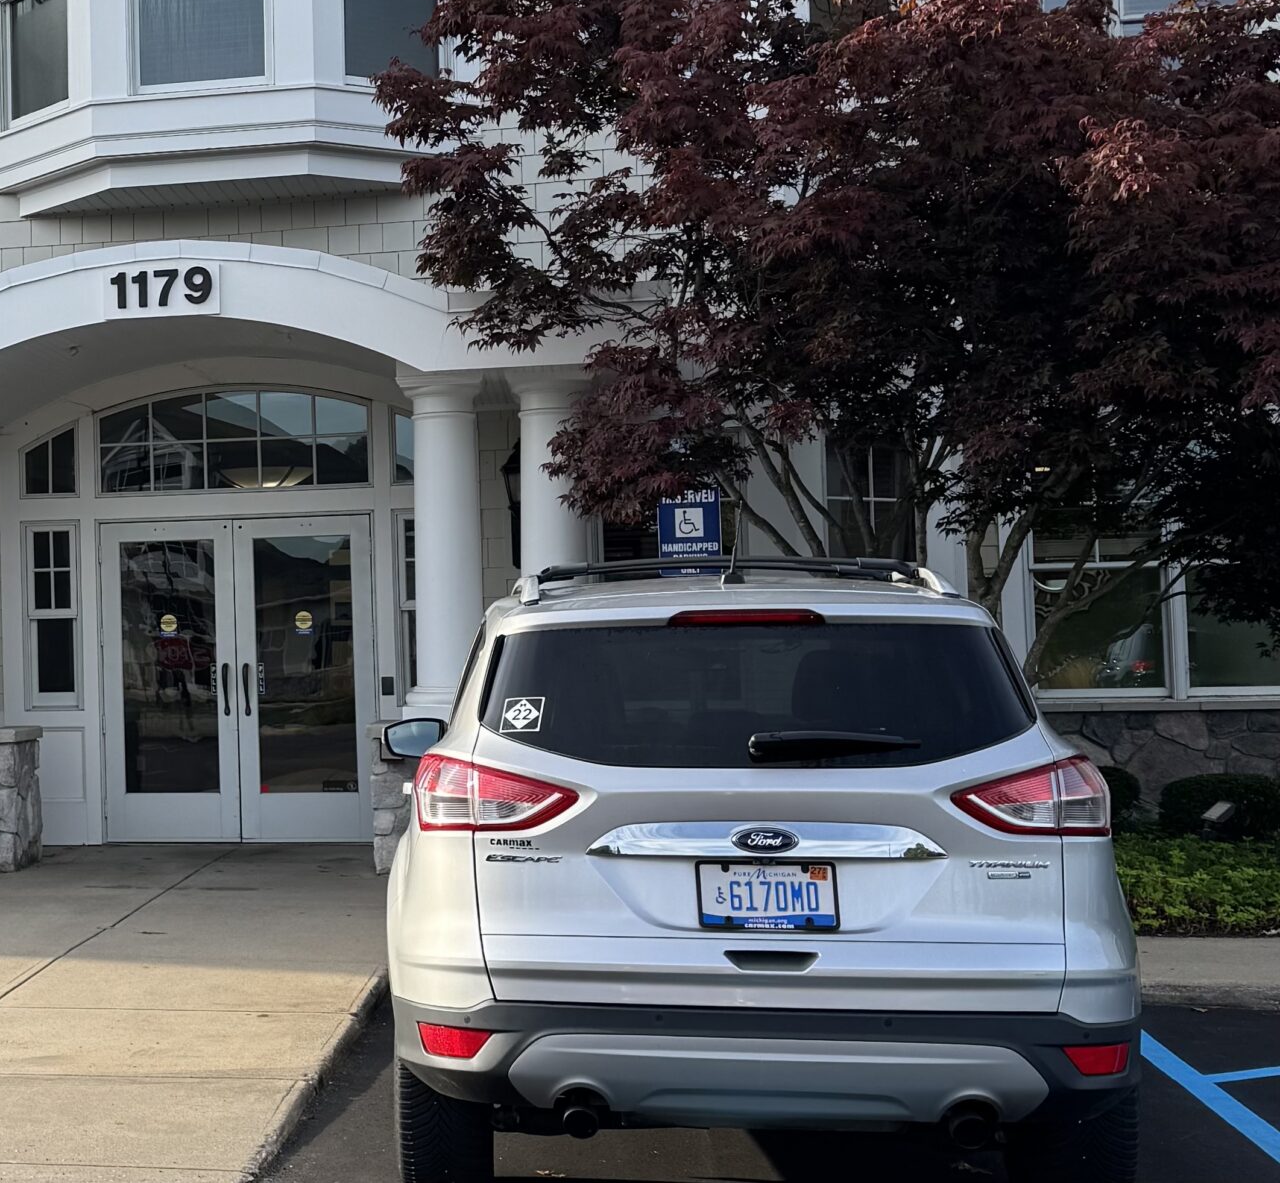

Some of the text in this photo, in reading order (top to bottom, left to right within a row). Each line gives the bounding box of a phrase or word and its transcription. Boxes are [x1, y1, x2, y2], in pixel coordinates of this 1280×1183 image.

[110, 266, 212, 309] 1179
[662, 489, 716, 504] SERVED
[661, 542, 719, 553] HANDICAPPED
[511, 708, 532, 721] 22
[747, 831, 783, 846] Ford
[486, 854, 563, 863] ESCAPE
[810, 866, 822, 875] 27
[748, 917, 788, 925] michigan.org
